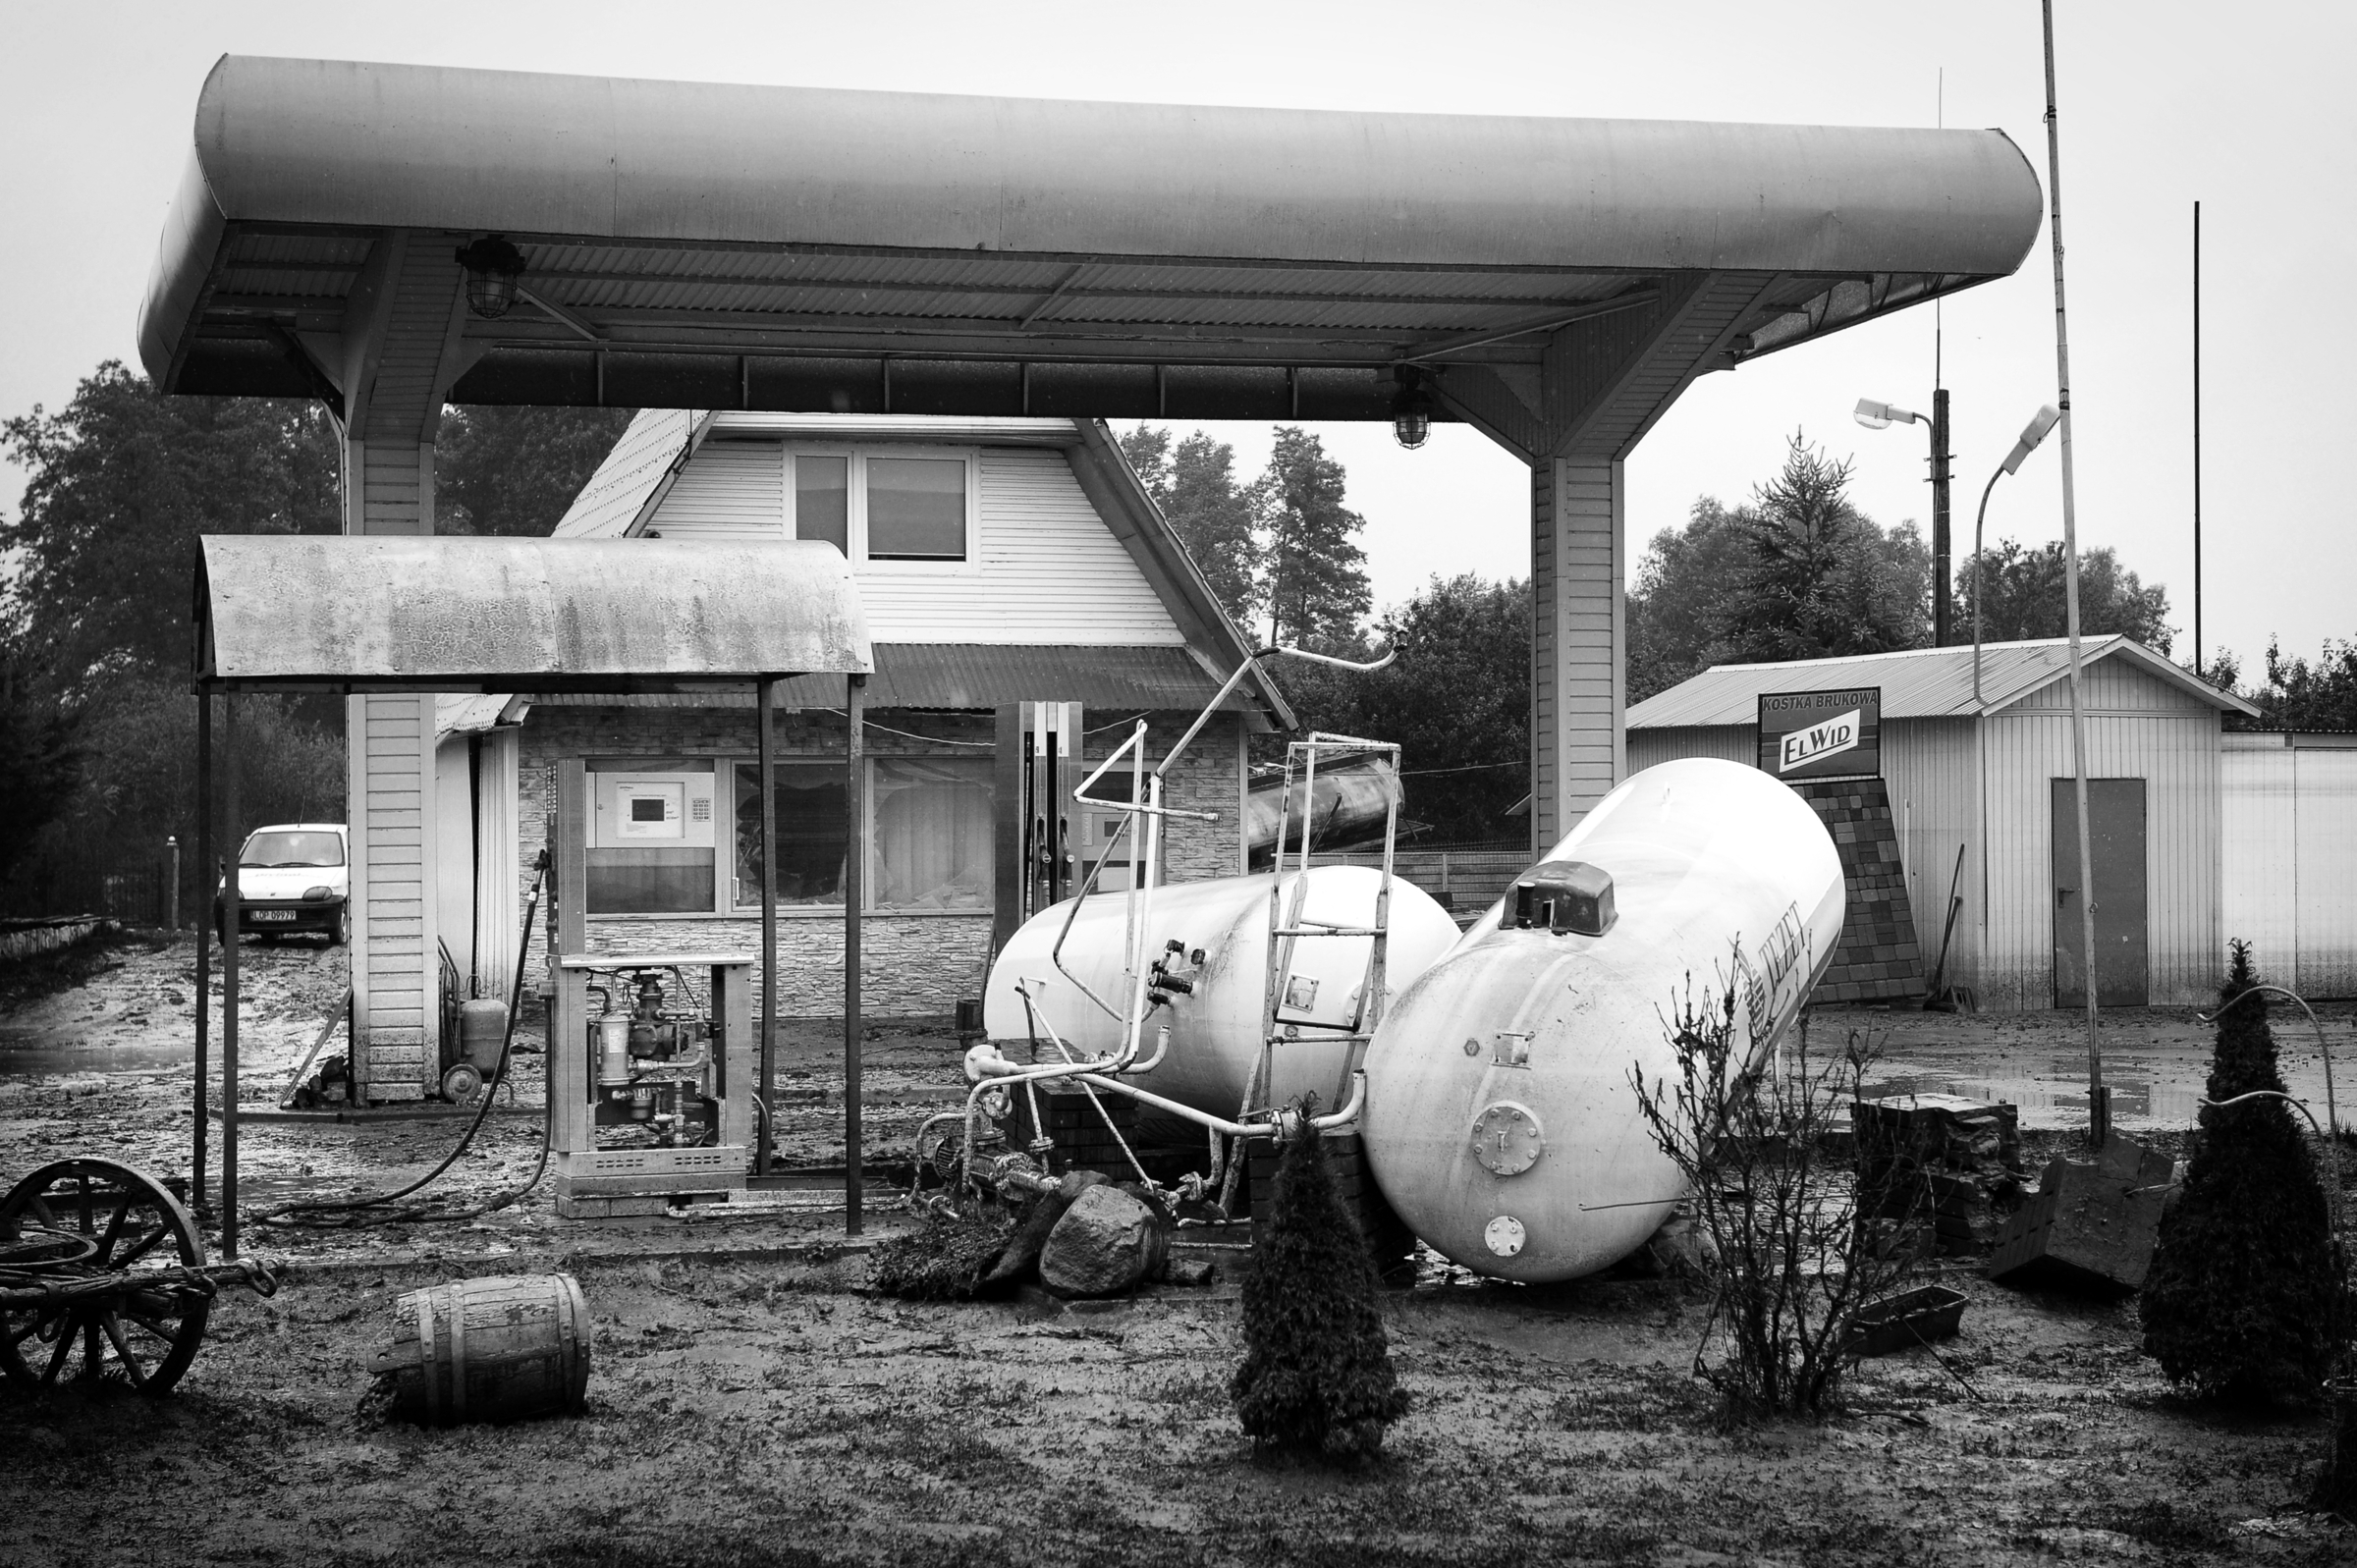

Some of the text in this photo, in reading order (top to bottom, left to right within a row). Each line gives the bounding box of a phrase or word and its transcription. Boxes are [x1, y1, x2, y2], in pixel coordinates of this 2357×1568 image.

[1763, 691, 1877, 711] KOSTKA BRUKOWA
[271, 911, 295, 920] 09979
[1758, 899, 1805, 998] TEZET
